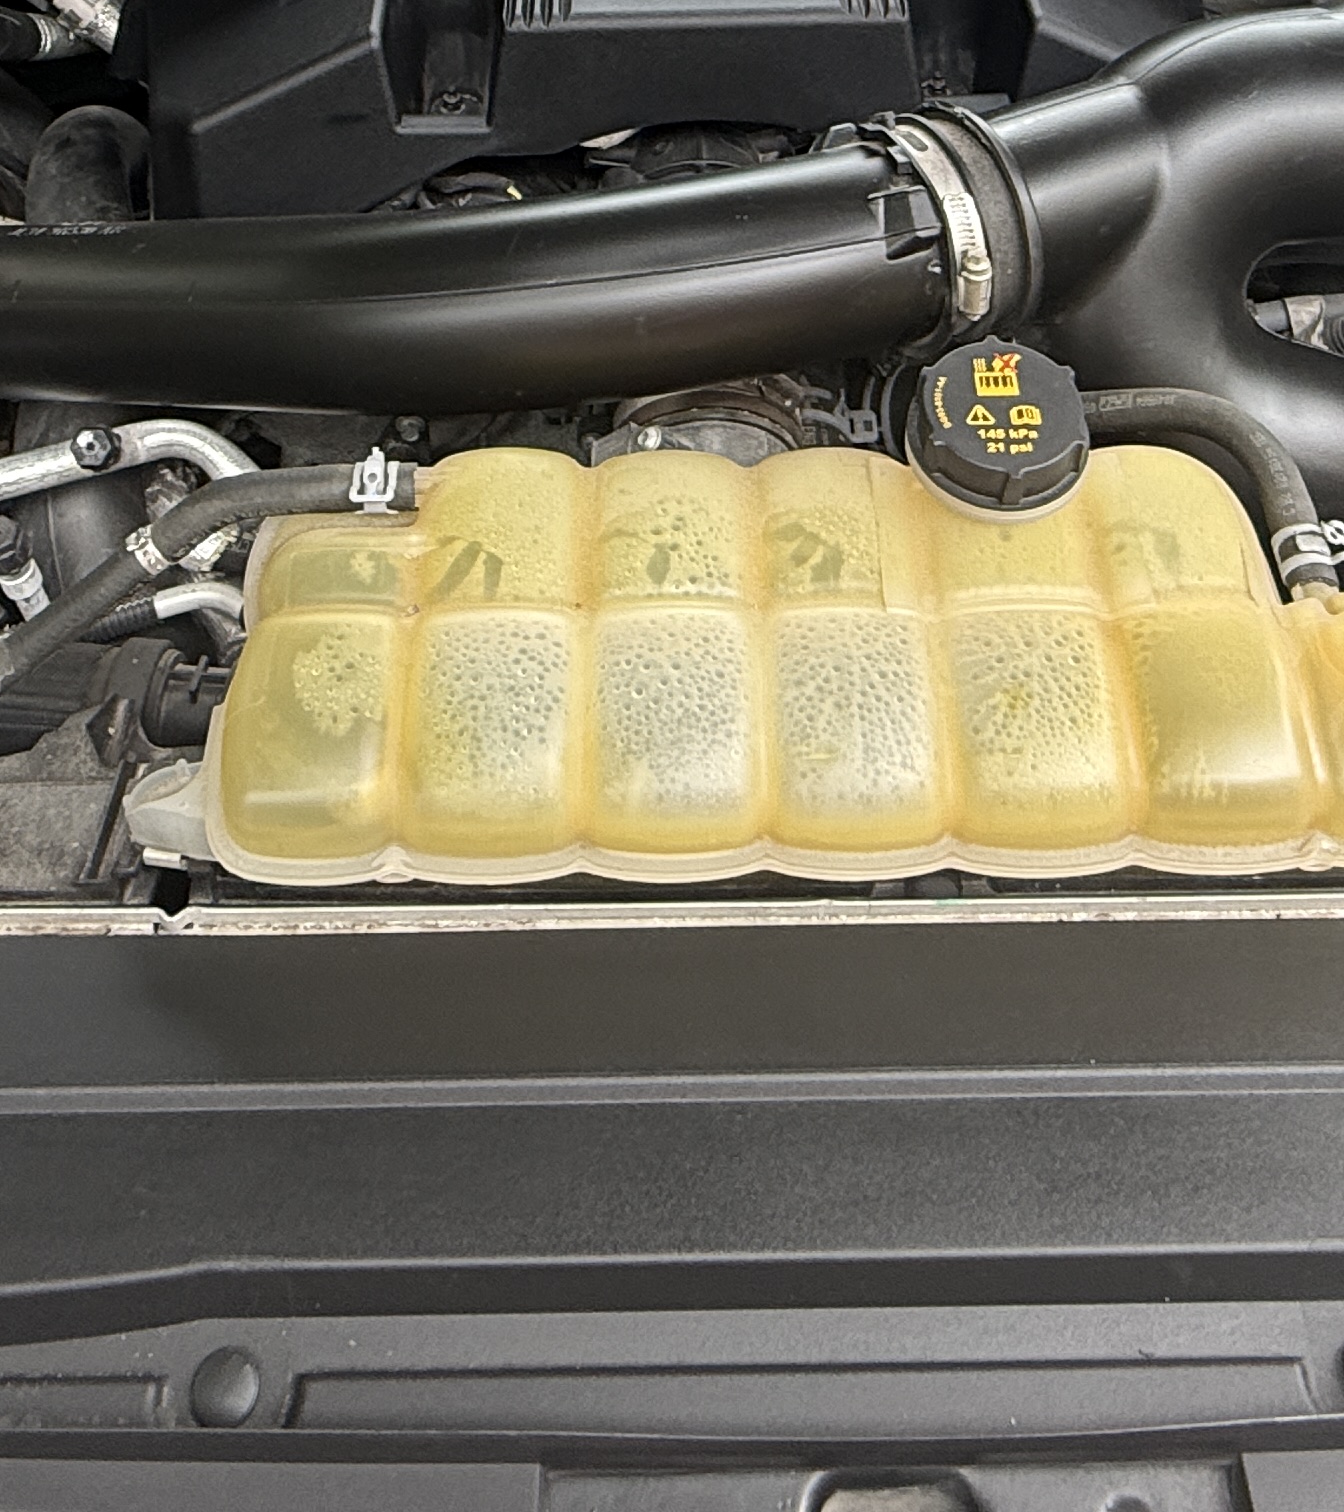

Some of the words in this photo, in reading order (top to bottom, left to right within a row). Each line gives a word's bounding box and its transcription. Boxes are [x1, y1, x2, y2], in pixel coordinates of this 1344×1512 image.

[976, 428, 1006, 439] 145
[1008, 428, 1039, 440] kPa
[986, 442, 1005, 453] 21
[1009, 441, 1034, 455] psi
